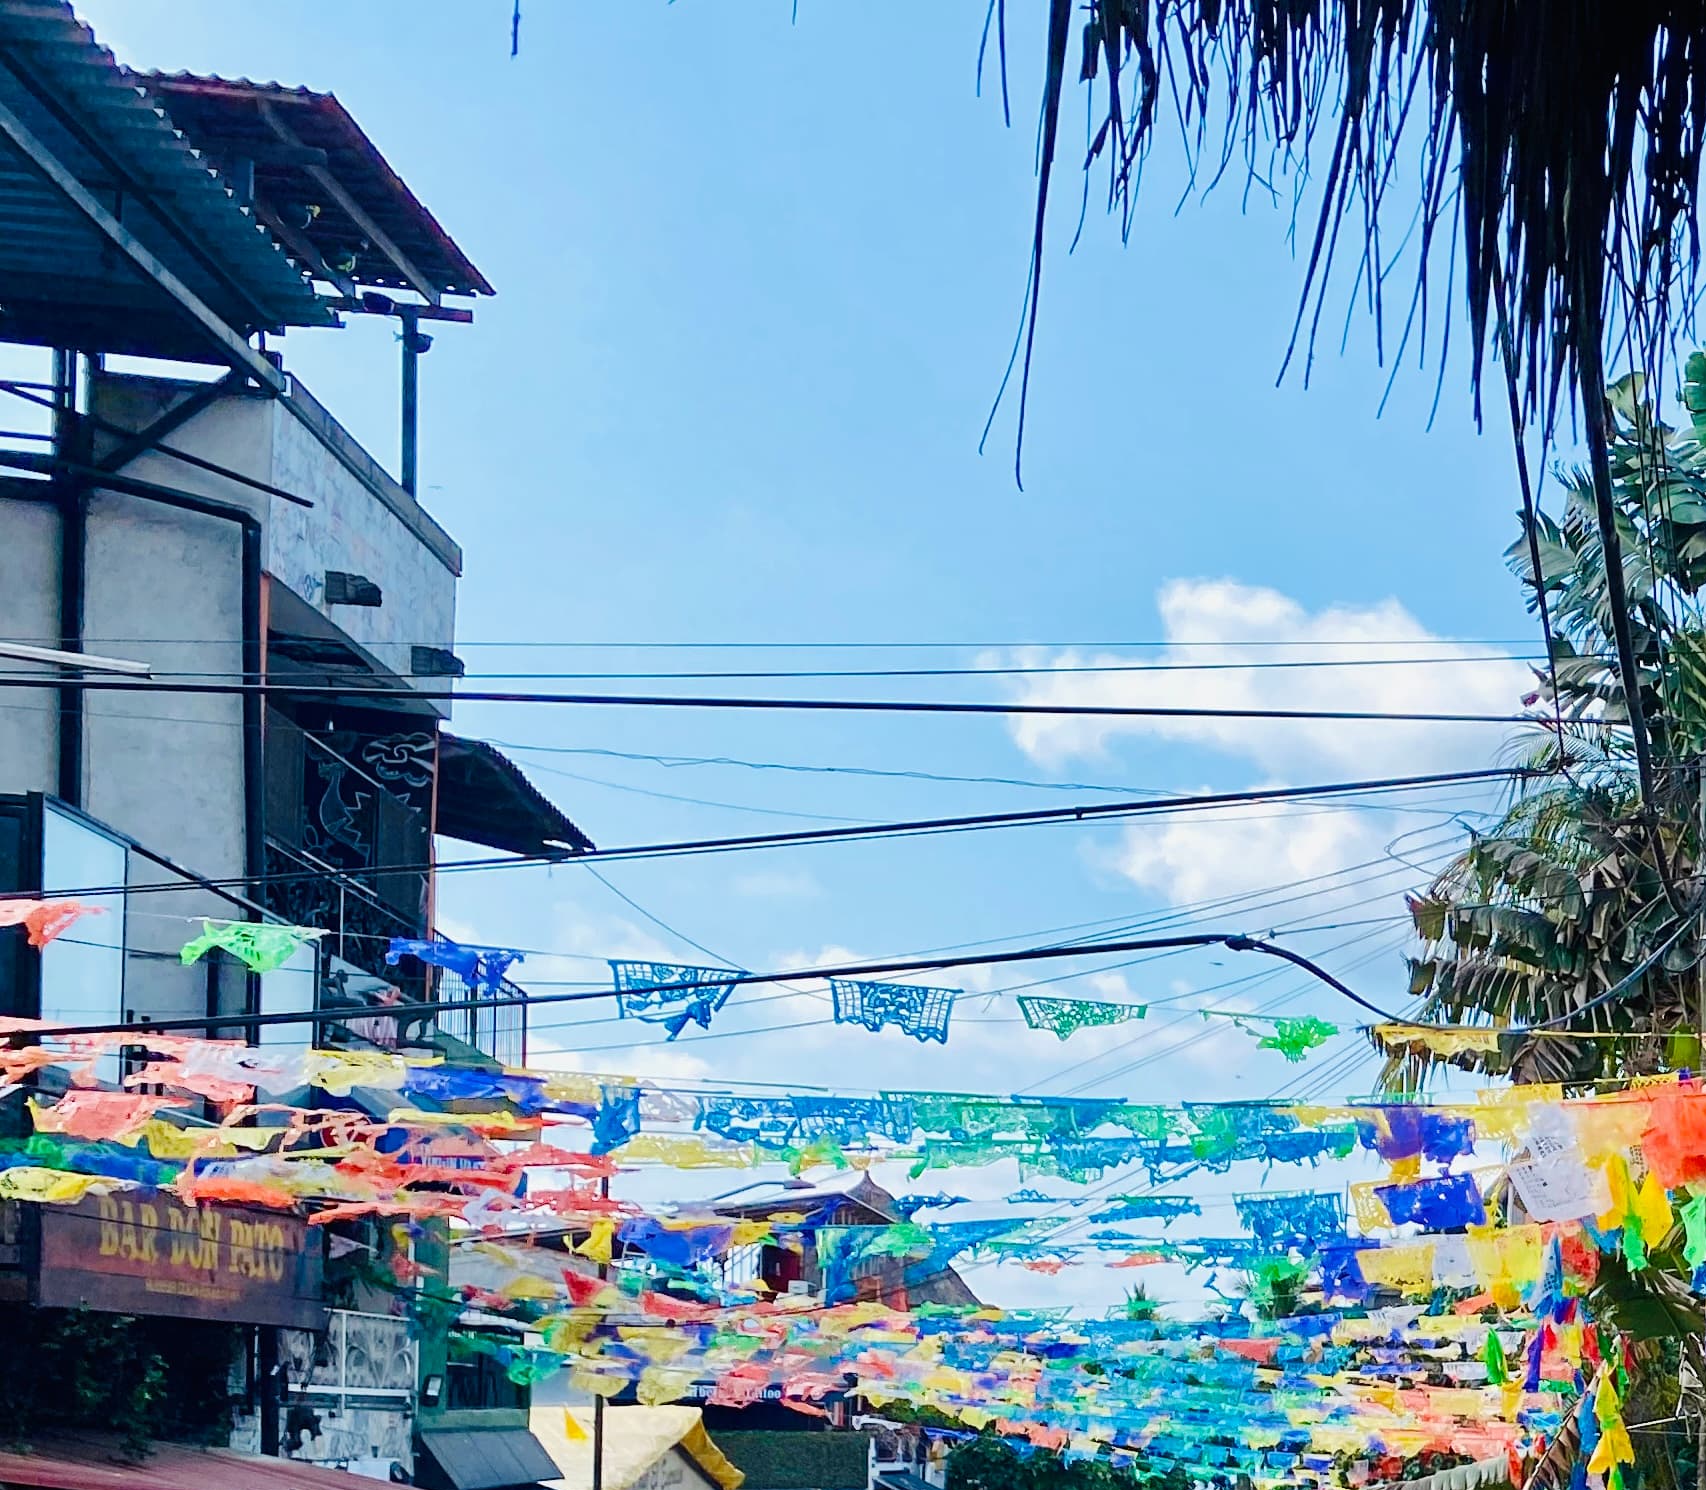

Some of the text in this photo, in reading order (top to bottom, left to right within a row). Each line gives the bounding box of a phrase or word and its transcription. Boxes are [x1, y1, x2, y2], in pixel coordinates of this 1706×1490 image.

[100, 1196, 284, 1282] BAR DON PATO
